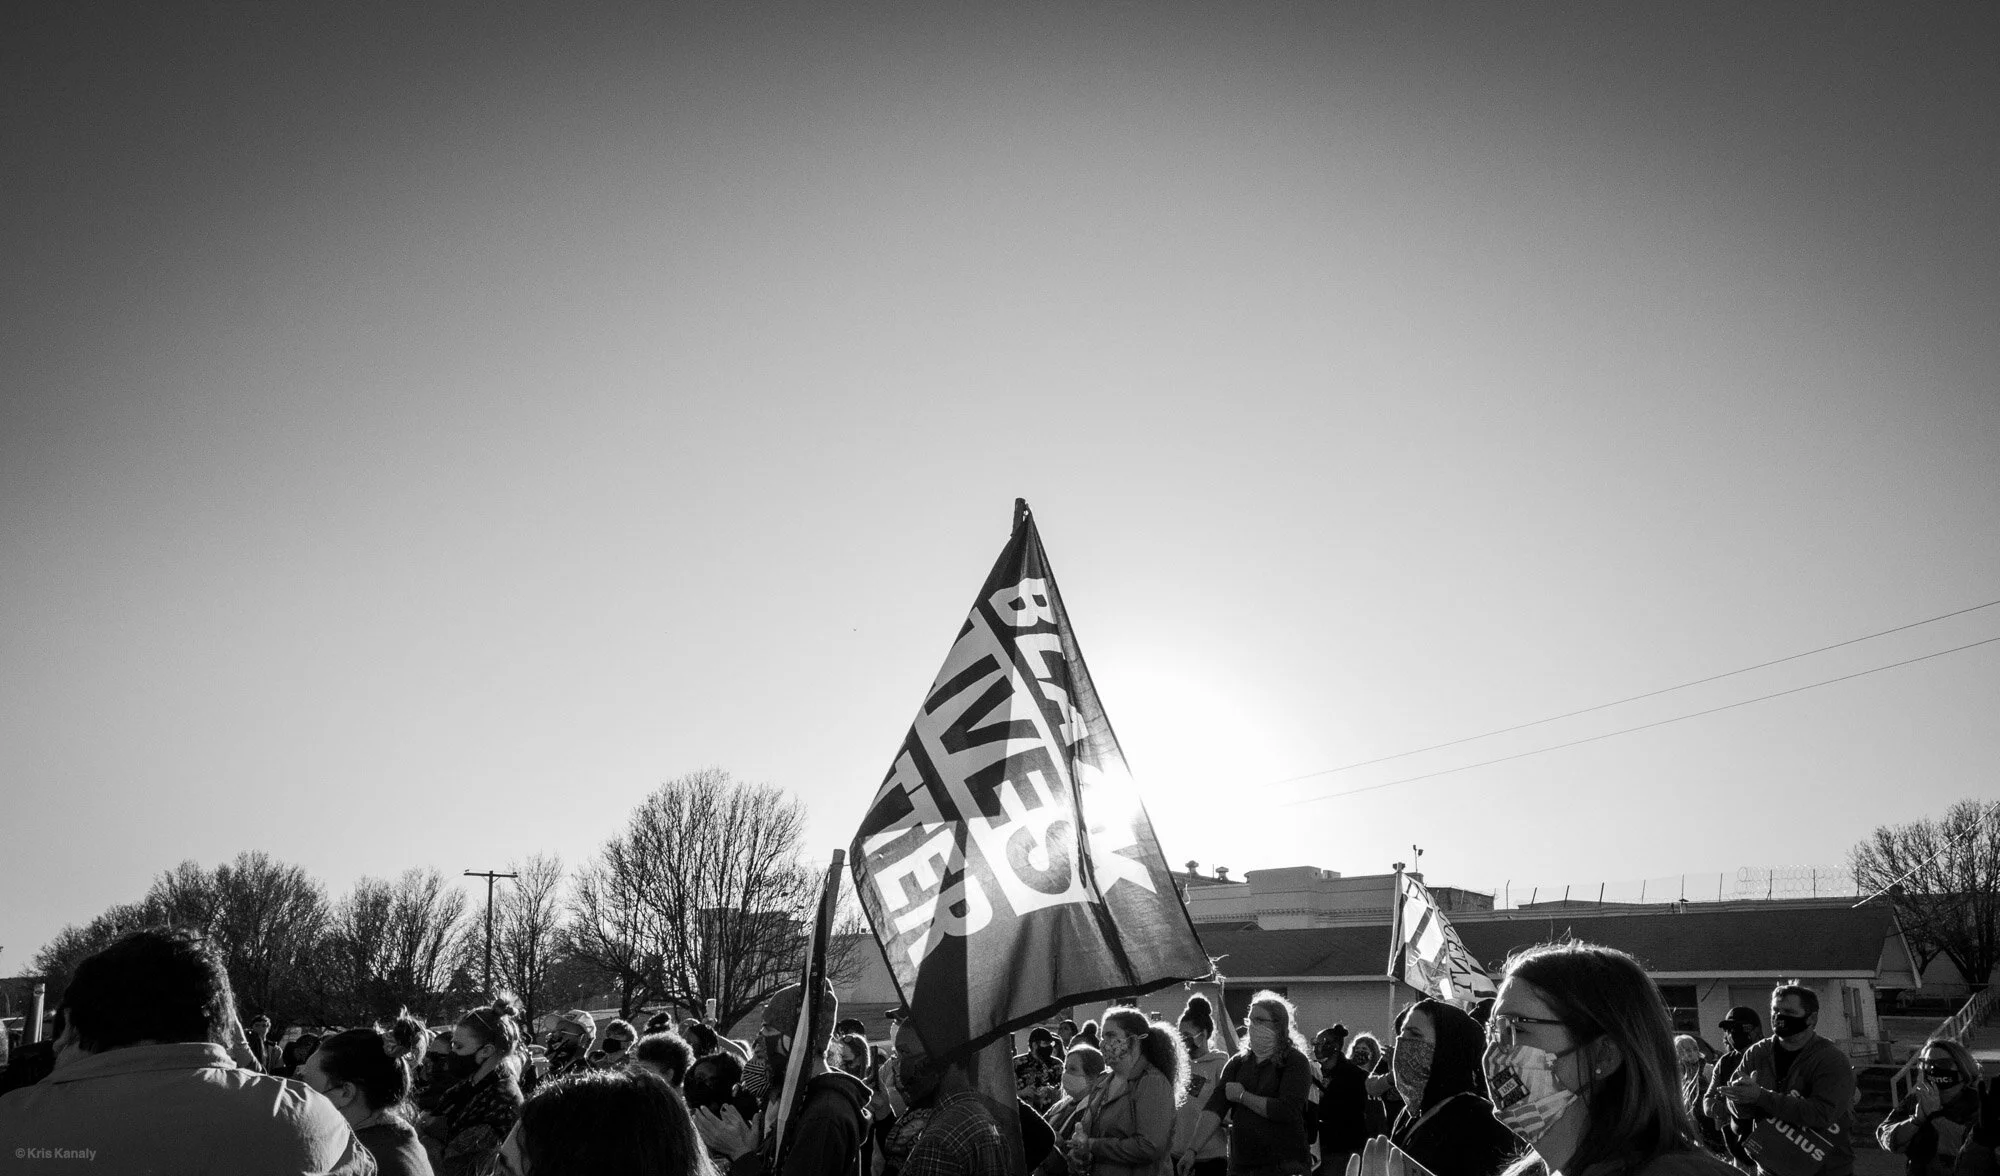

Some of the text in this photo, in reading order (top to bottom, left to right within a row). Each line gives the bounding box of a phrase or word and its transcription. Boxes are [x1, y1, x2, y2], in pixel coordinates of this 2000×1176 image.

[862, 749, 994, 969] TTER
[924, 618, 1073, 896] IVES
[988, 577, 1158, 896] BLAK
[1766, 1117, 1825, 1161] JULIUS
